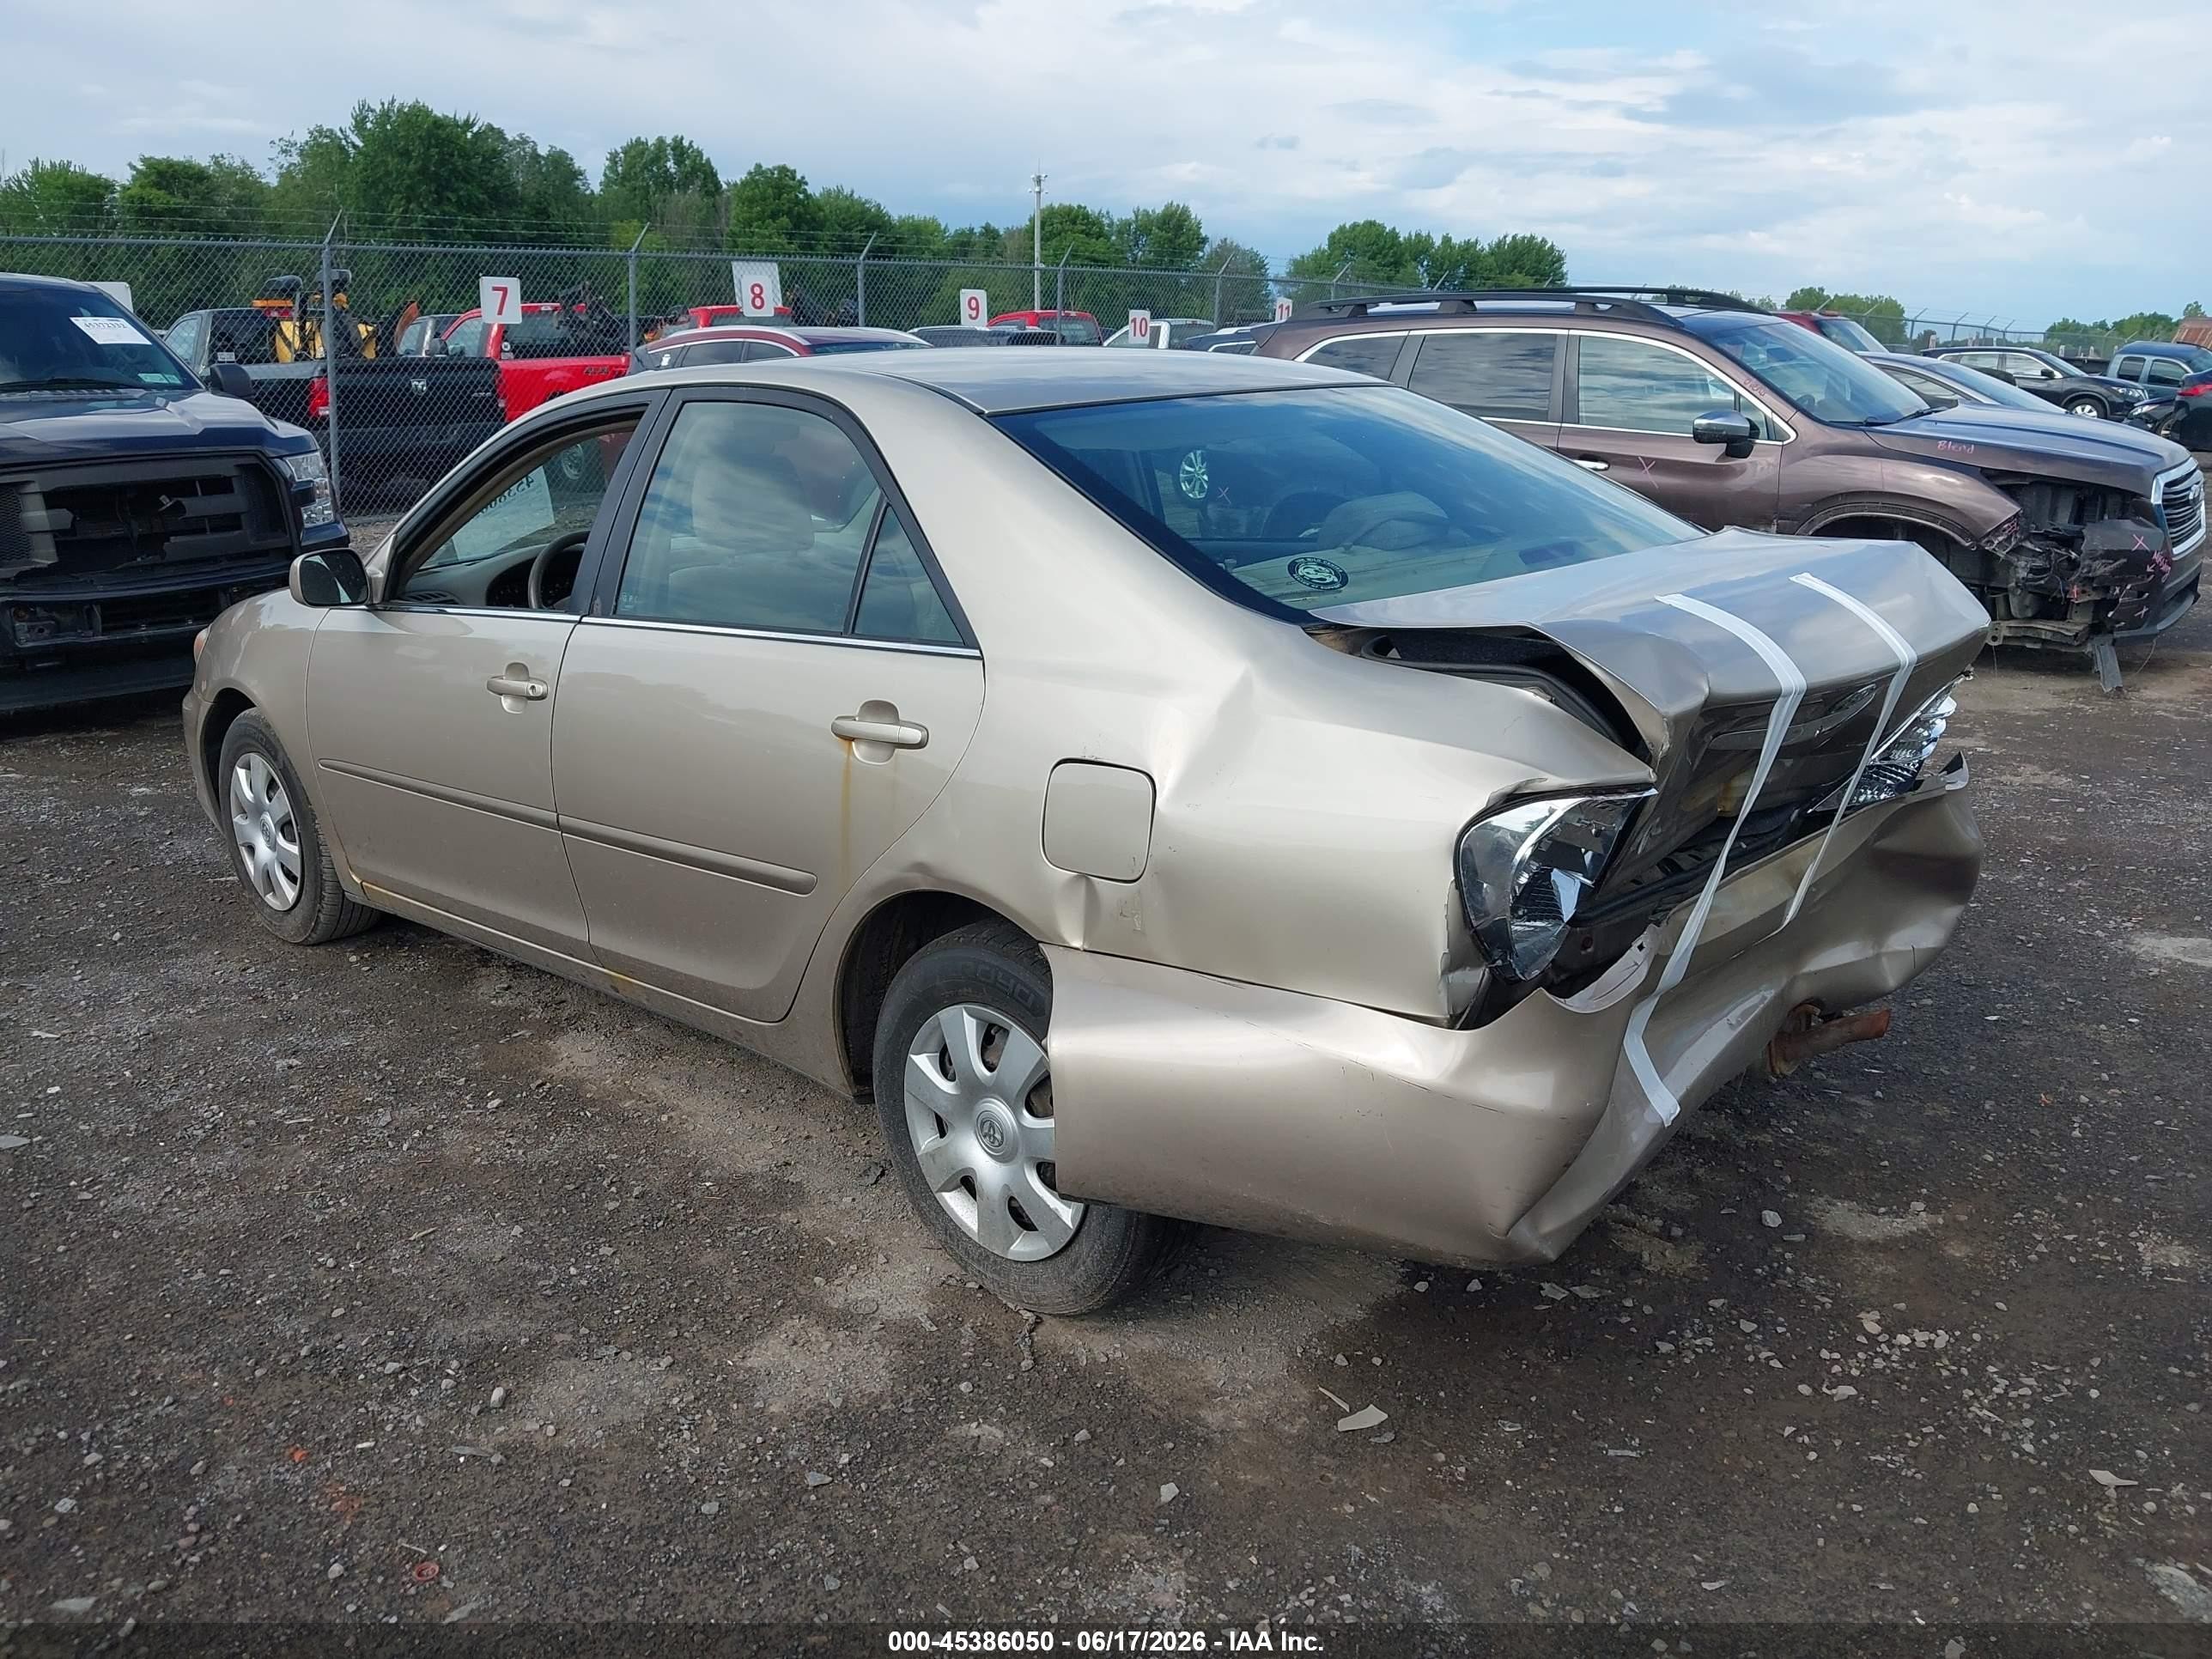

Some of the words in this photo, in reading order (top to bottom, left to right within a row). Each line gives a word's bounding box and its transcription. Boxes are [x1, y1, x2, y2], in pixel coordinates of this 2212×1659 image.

[491, 286, 508, 316] 7
[750, 283, 765, 310] 8
[967, 296, 980, 320] 9
[1278, 303, 1291, 321] 11
[1130, 317, 1148, 337] 10
[1936, 439, 1976, 454] Blend
